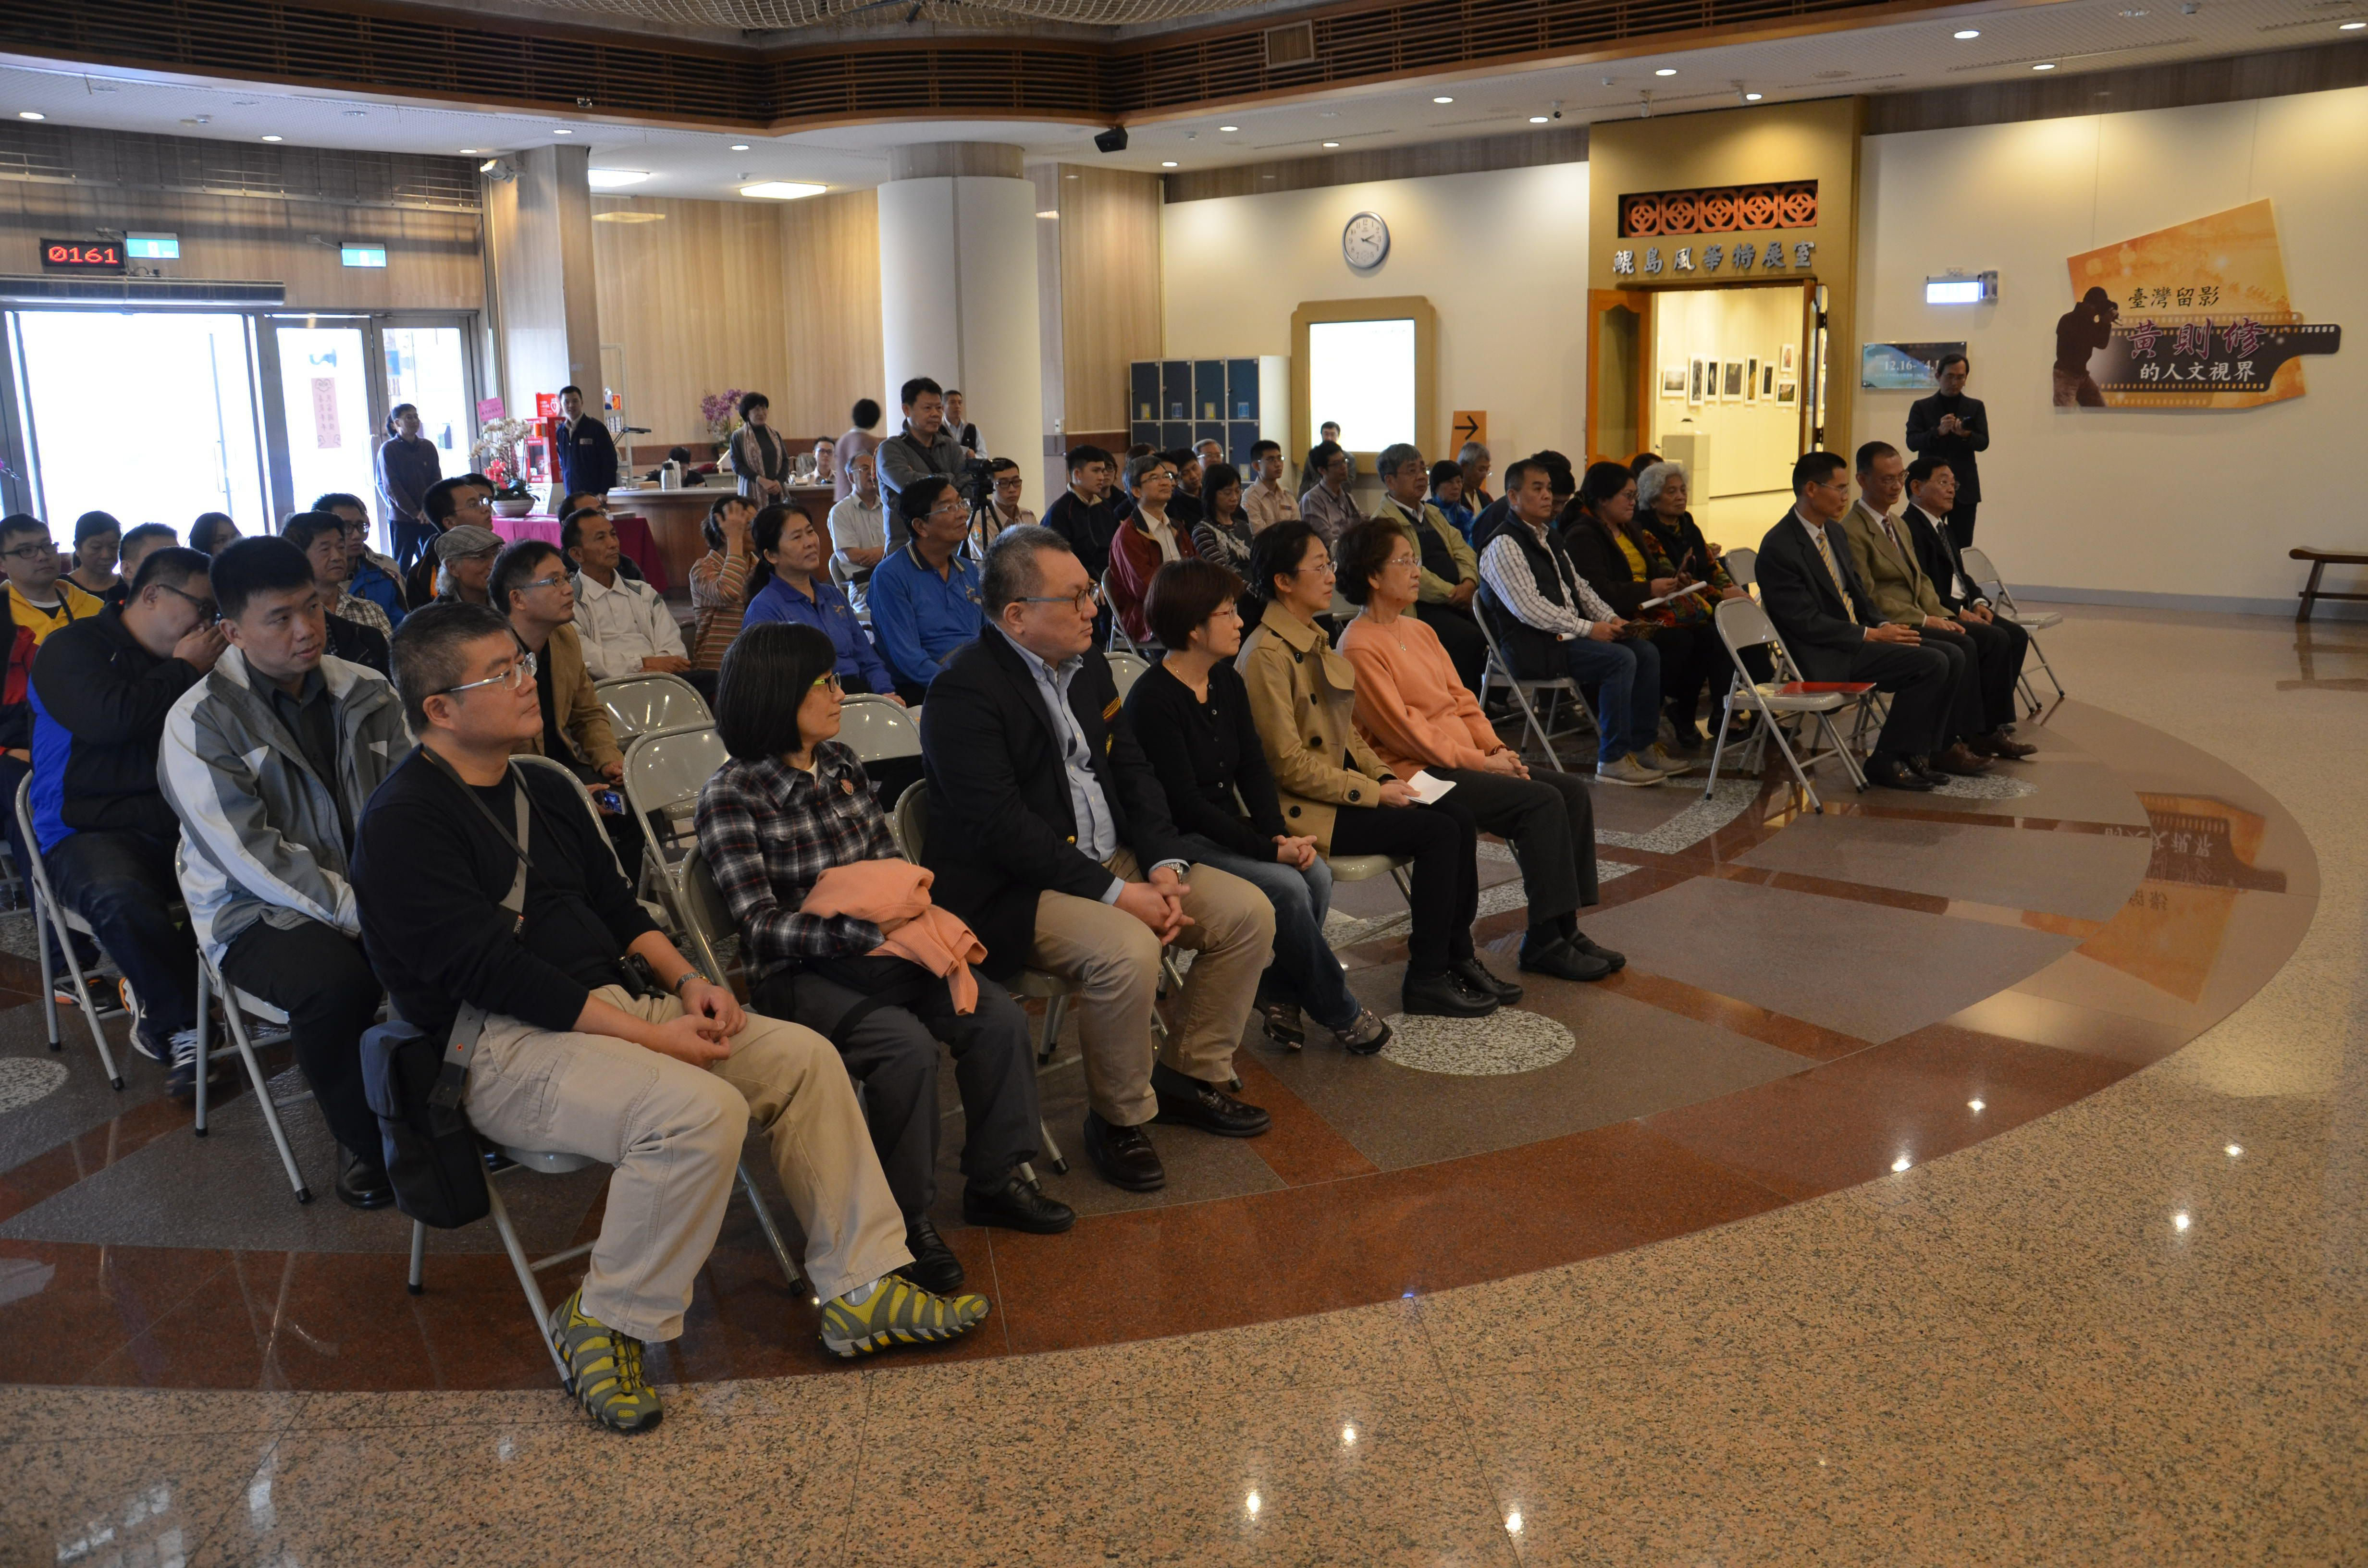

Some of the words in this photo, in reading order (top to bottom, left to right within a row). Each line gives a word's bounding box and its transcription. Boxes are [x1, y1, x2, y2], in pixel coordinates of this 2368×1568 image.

[49, 245, 118, 264] 0161
[1613, 240, 1815, 275] 鯤島風華特展室
[2128, 285, 2220, 309] 臺灣留影
[2126, 317, 2268, 360] 黃則修
[2140, 361, 2256, 382] 的人文視界
